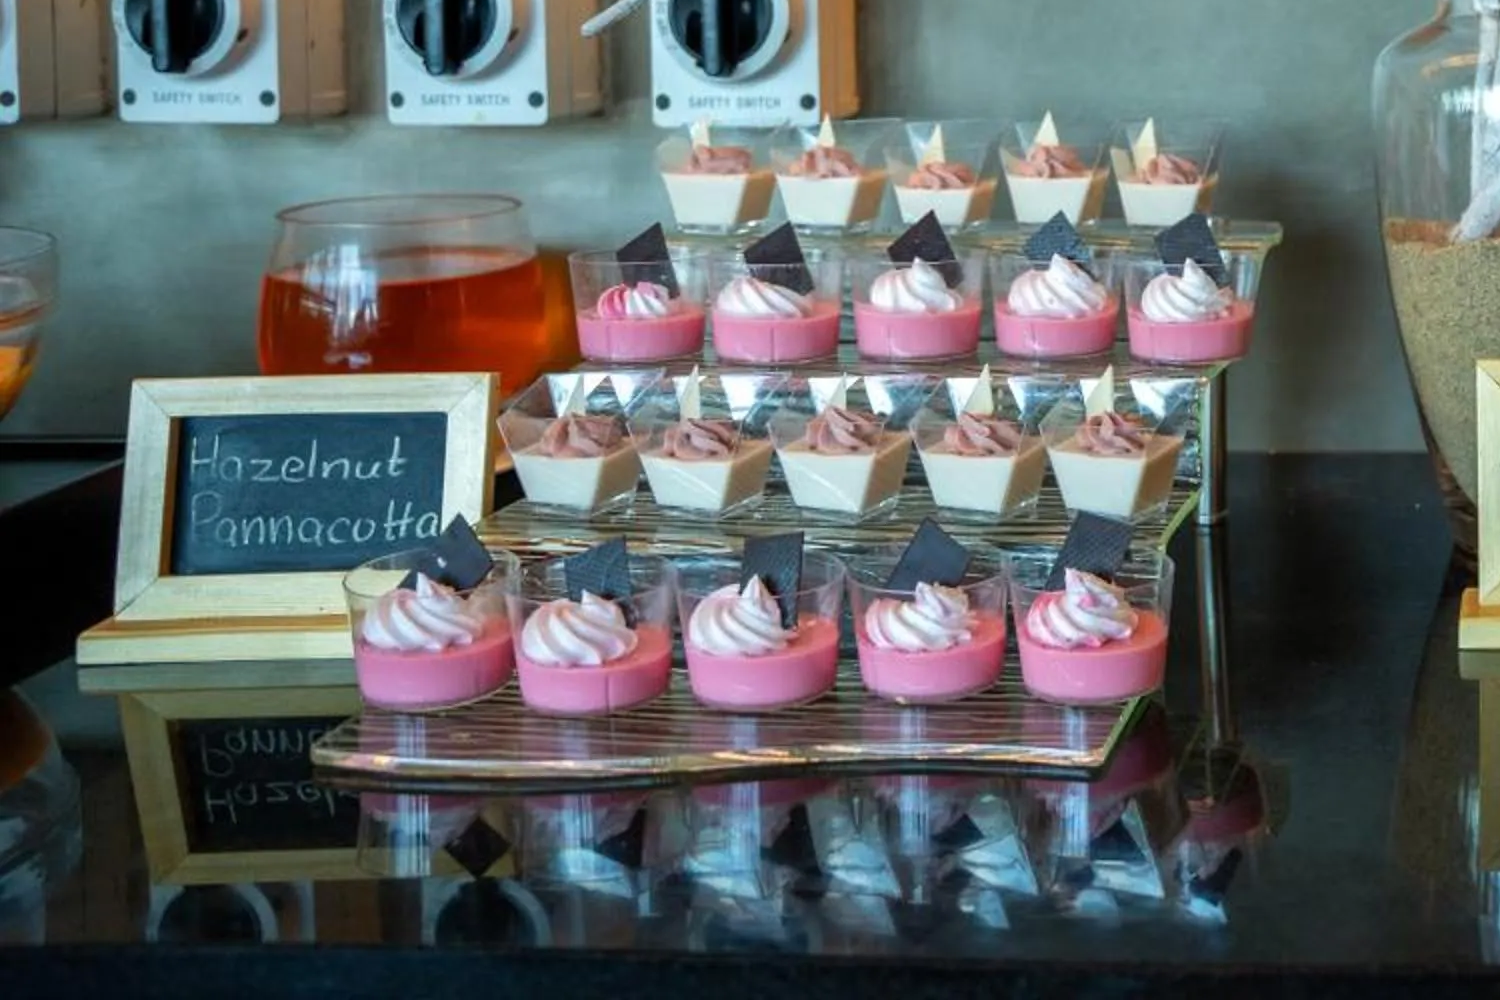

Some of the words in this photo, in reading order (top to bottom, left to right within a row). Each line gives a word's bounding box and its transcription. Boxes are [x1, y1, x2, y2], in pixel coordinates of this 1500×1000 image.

[152, 92, 192, 104] SAFETY
[199, 92, 243, 104] SWITCH
[421, 94, 461, 106] SAFETY
[467, 94, 511, 106] SWITCH
[689, 96, 731, 108] SAFETY
[737, 96, 781, 108] SWITCH
[190, 433, 408, 483] Hazelnut
[190, 490, 442, 546] Pannacotta
